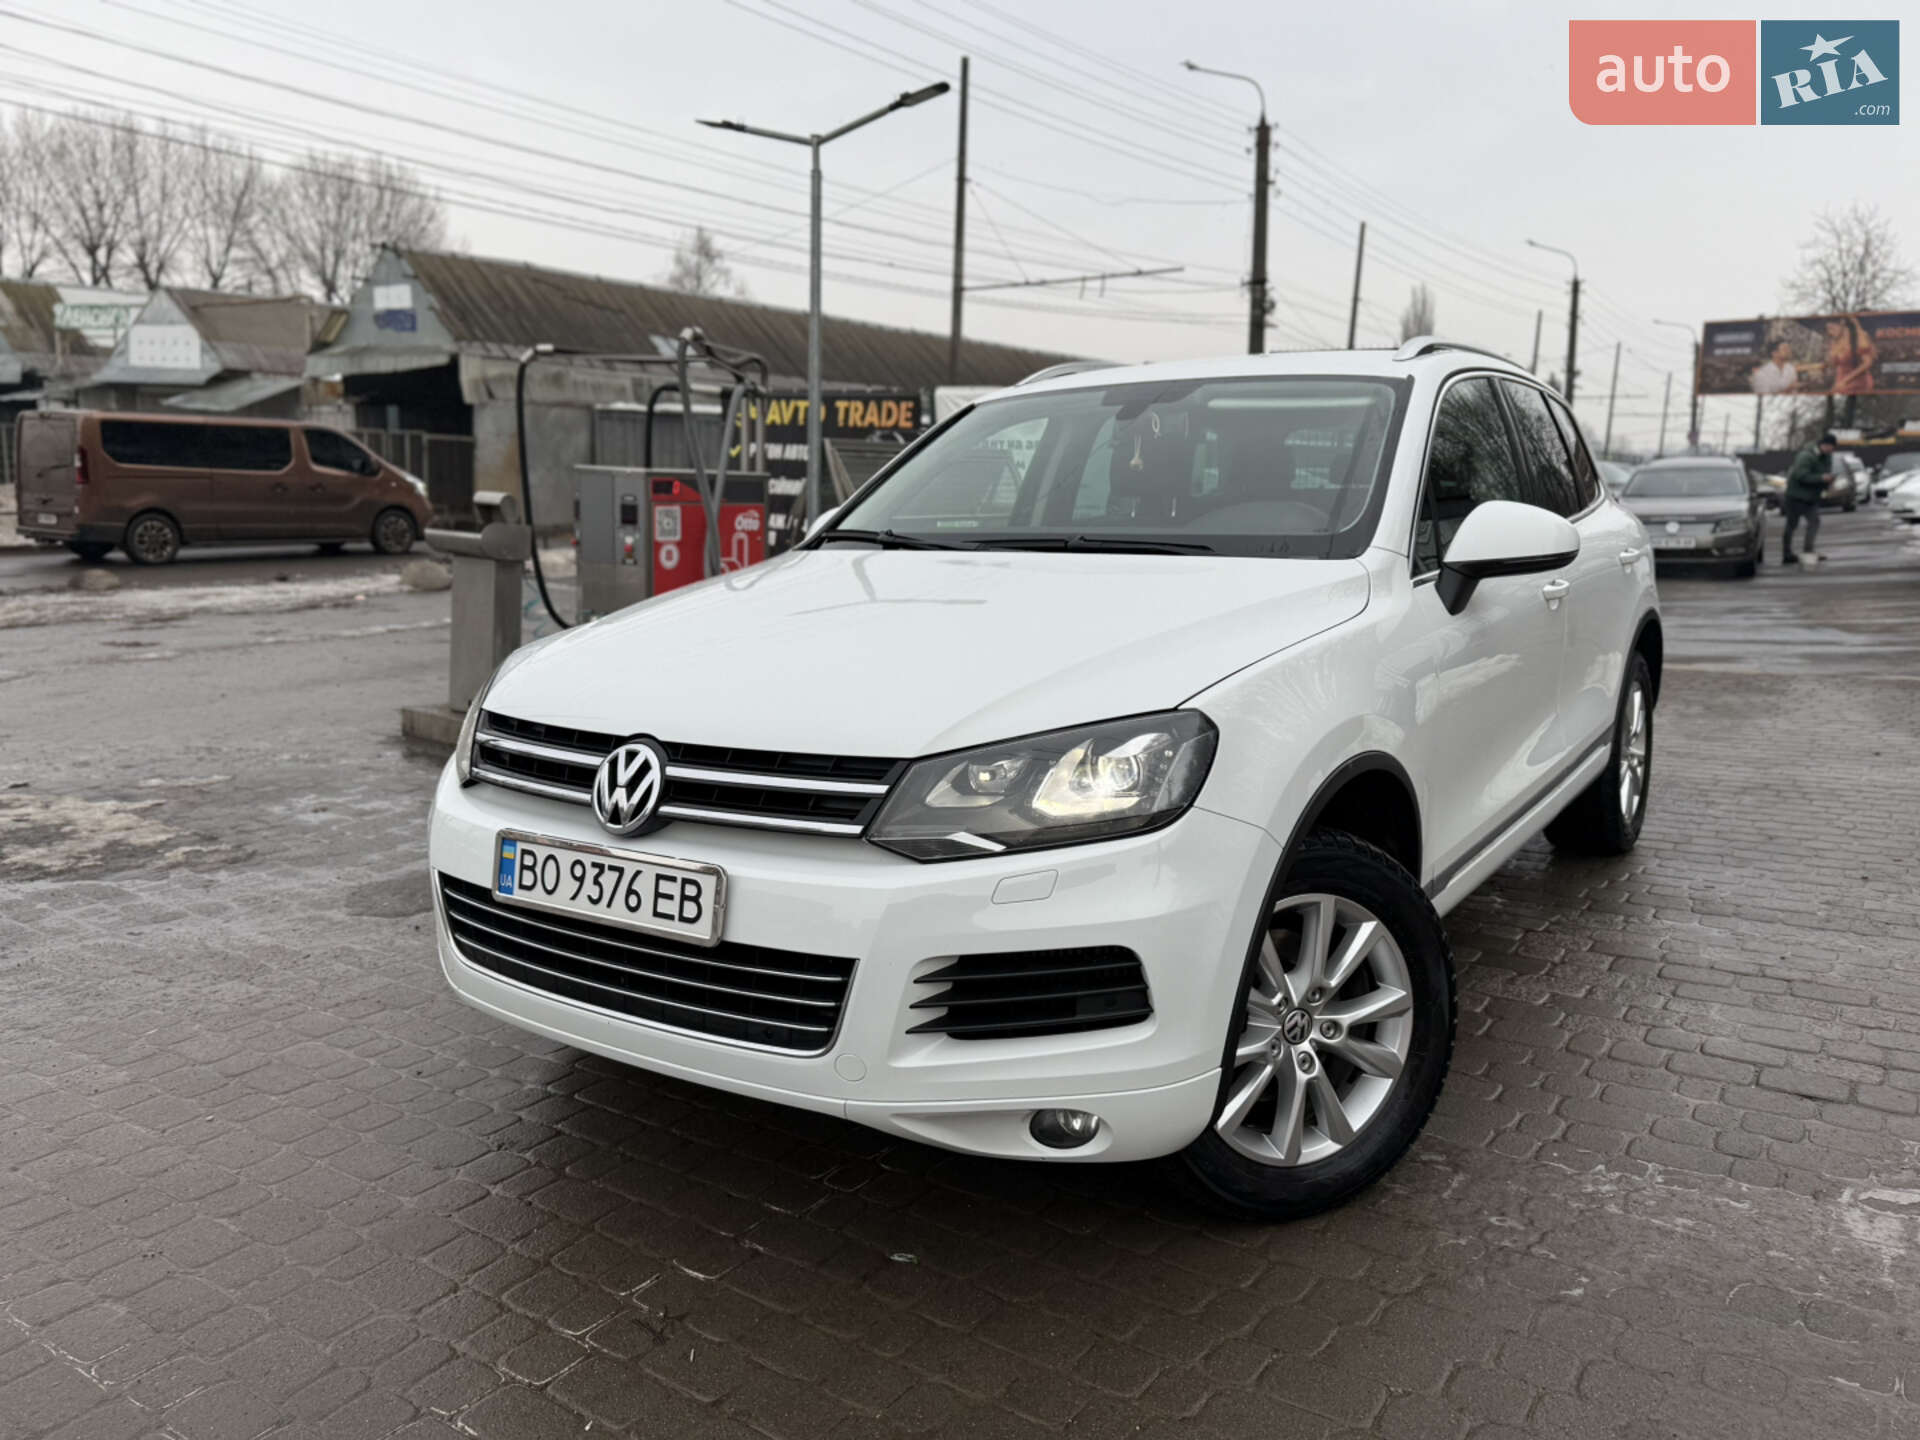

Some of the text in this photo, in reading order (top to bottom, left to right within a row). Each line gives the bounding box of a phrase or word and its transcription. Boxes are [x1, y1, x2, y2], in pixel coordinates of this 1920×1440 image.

[835, 401, 914, 428] TRADE
[500, 873, 513, 888] UA
[518, 848, 703, 924] BO 9376 EB
